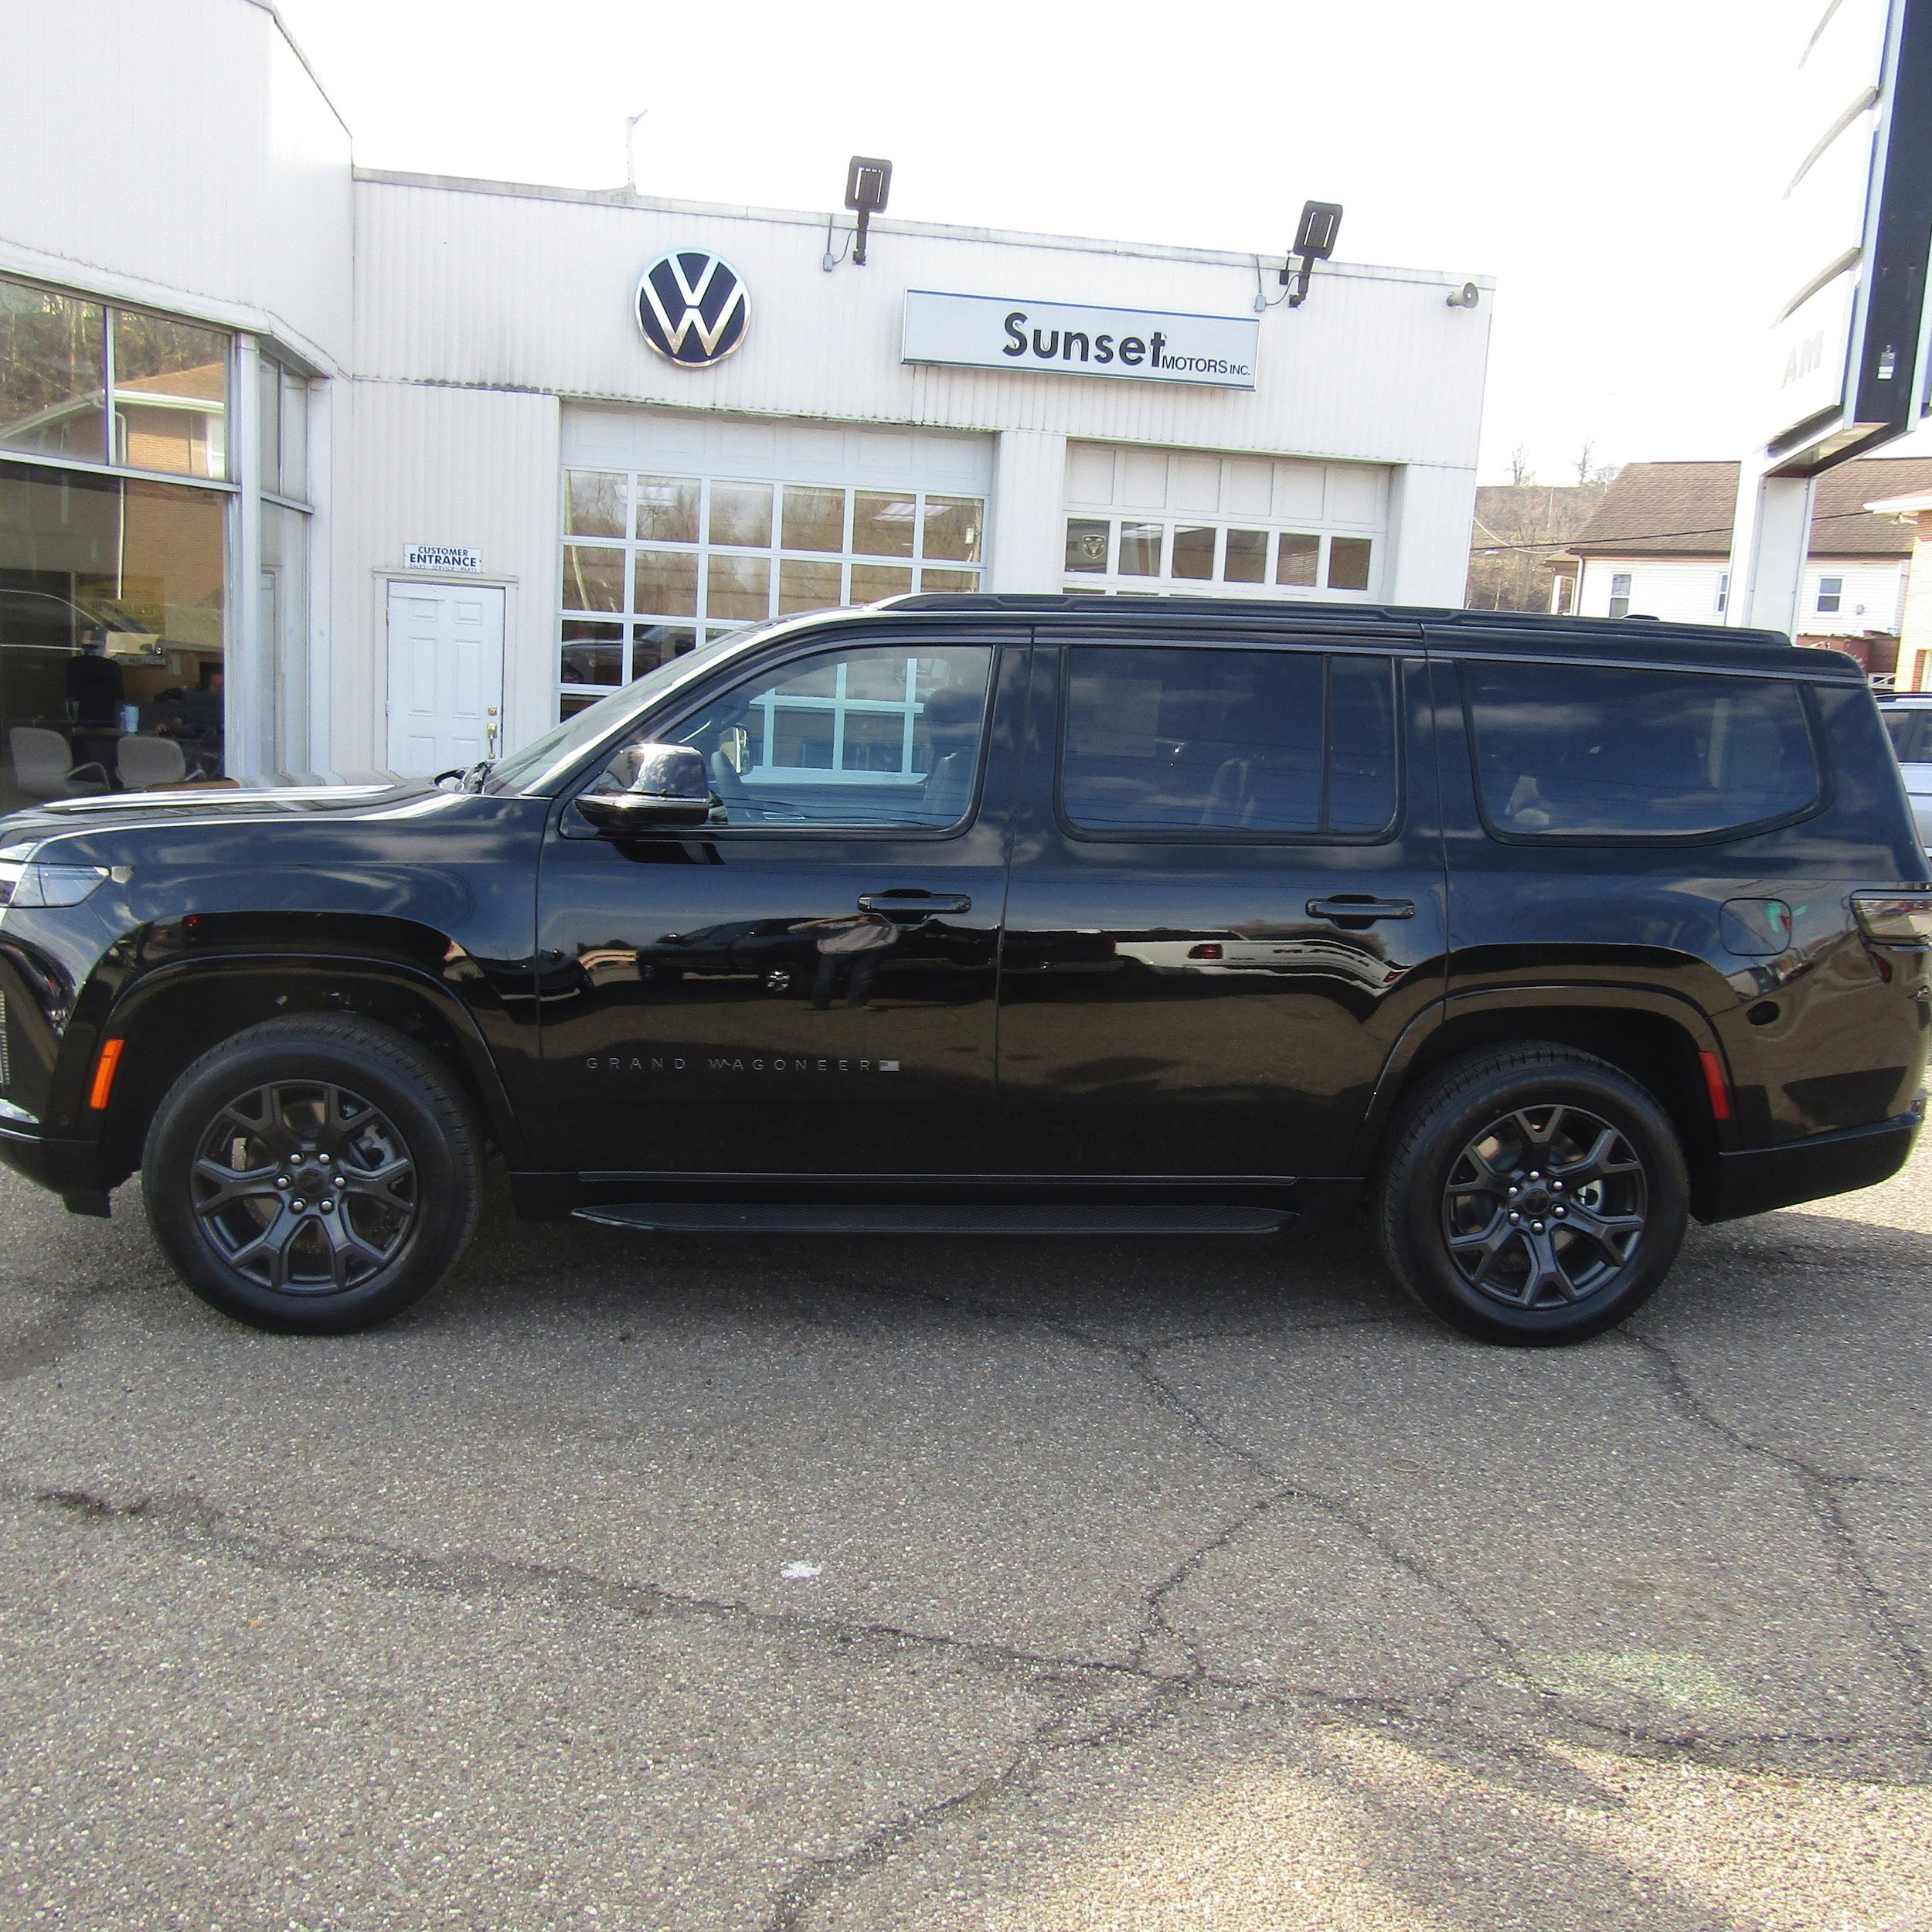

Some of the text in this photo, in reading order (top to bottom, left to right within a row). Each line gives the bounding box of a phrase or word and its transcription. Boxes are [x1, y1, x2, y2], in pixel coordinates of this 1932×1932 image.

[1002, 311, 1250, 376] Sunset MOTORS INC.
[418, 546, 468, 556] CUSTOMER
[410, 553, 477, 566] ENTRANCE
[586, 1057, 872, 1072] GRAND WAGONEER
